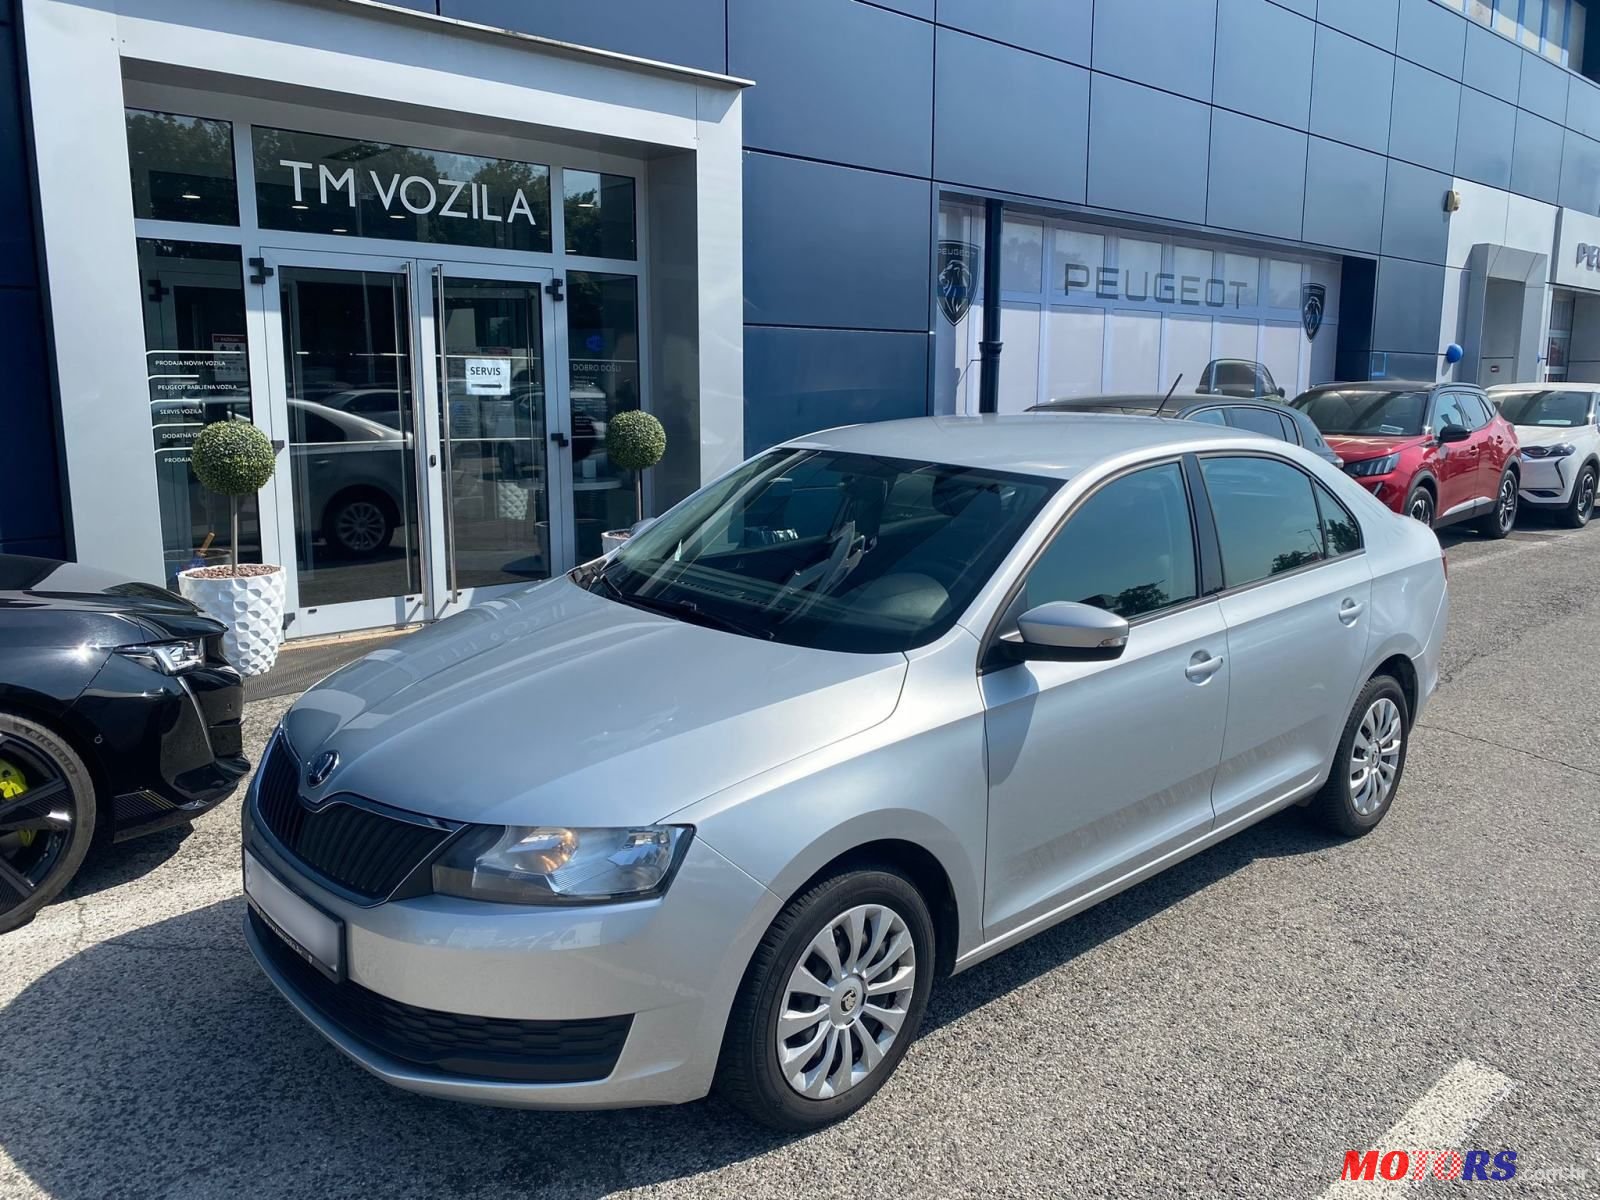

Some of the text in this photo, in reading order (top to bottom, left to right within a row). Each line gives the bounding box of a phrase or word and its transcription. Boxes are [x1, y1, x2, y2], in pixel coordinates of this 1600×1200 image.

[279, 159, 536, 226] TM VOZILA
[1065, 263, 1248, 310] PEUGEOT
[470, 366, 501, 376] SERVIS
[572, 363, 599, 372] DOBRO
